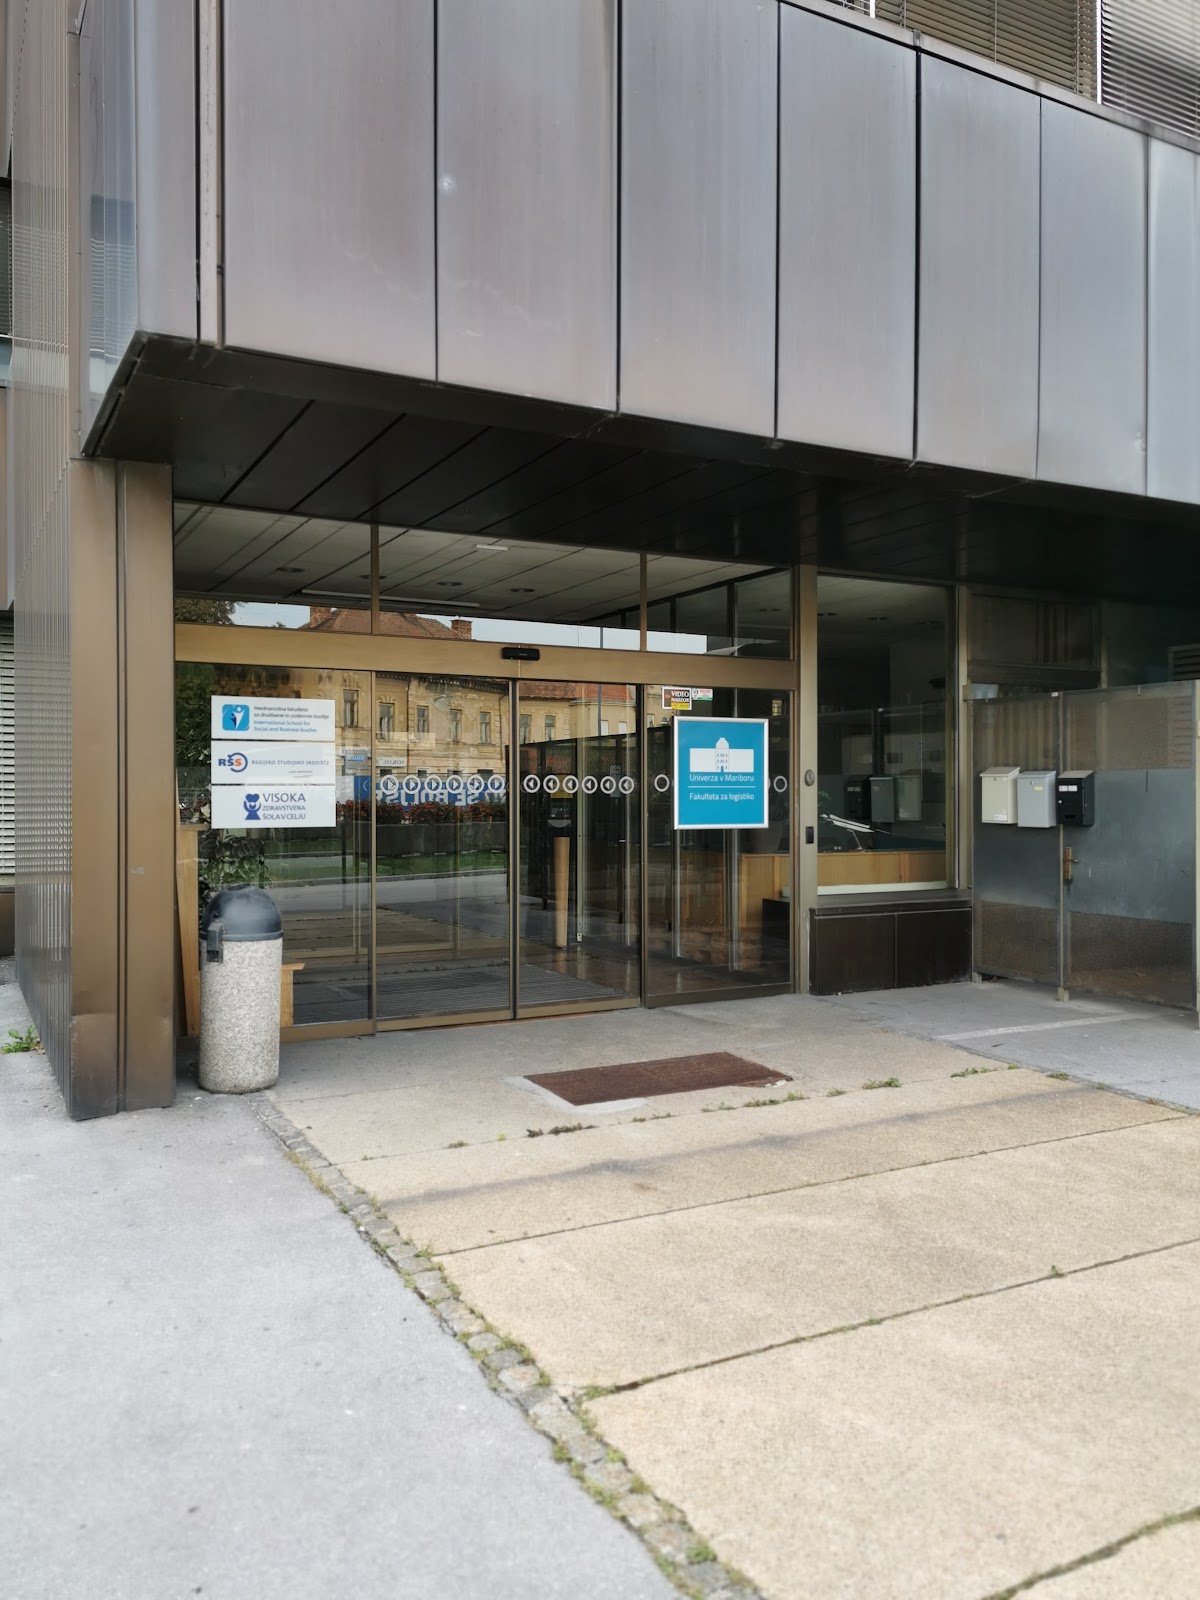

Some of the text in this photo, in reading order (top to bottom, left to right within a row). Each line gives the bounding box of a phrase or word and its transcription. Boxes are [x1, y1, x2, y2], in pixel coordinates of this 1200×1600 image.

[218, 754, 243, 767] RŠS
[252, 758, 330, 766] REGIJSKO ŠTUDIJSKO SREDIŠČE
[689, 774, 718, 782] Univerza
[725, 774, 754, 782] Mariboru
[262, 793, 306, 803] VISOKA
[689, 792, 719, 800] Fakulteta
[729, 792, 755, 802] logistiko
